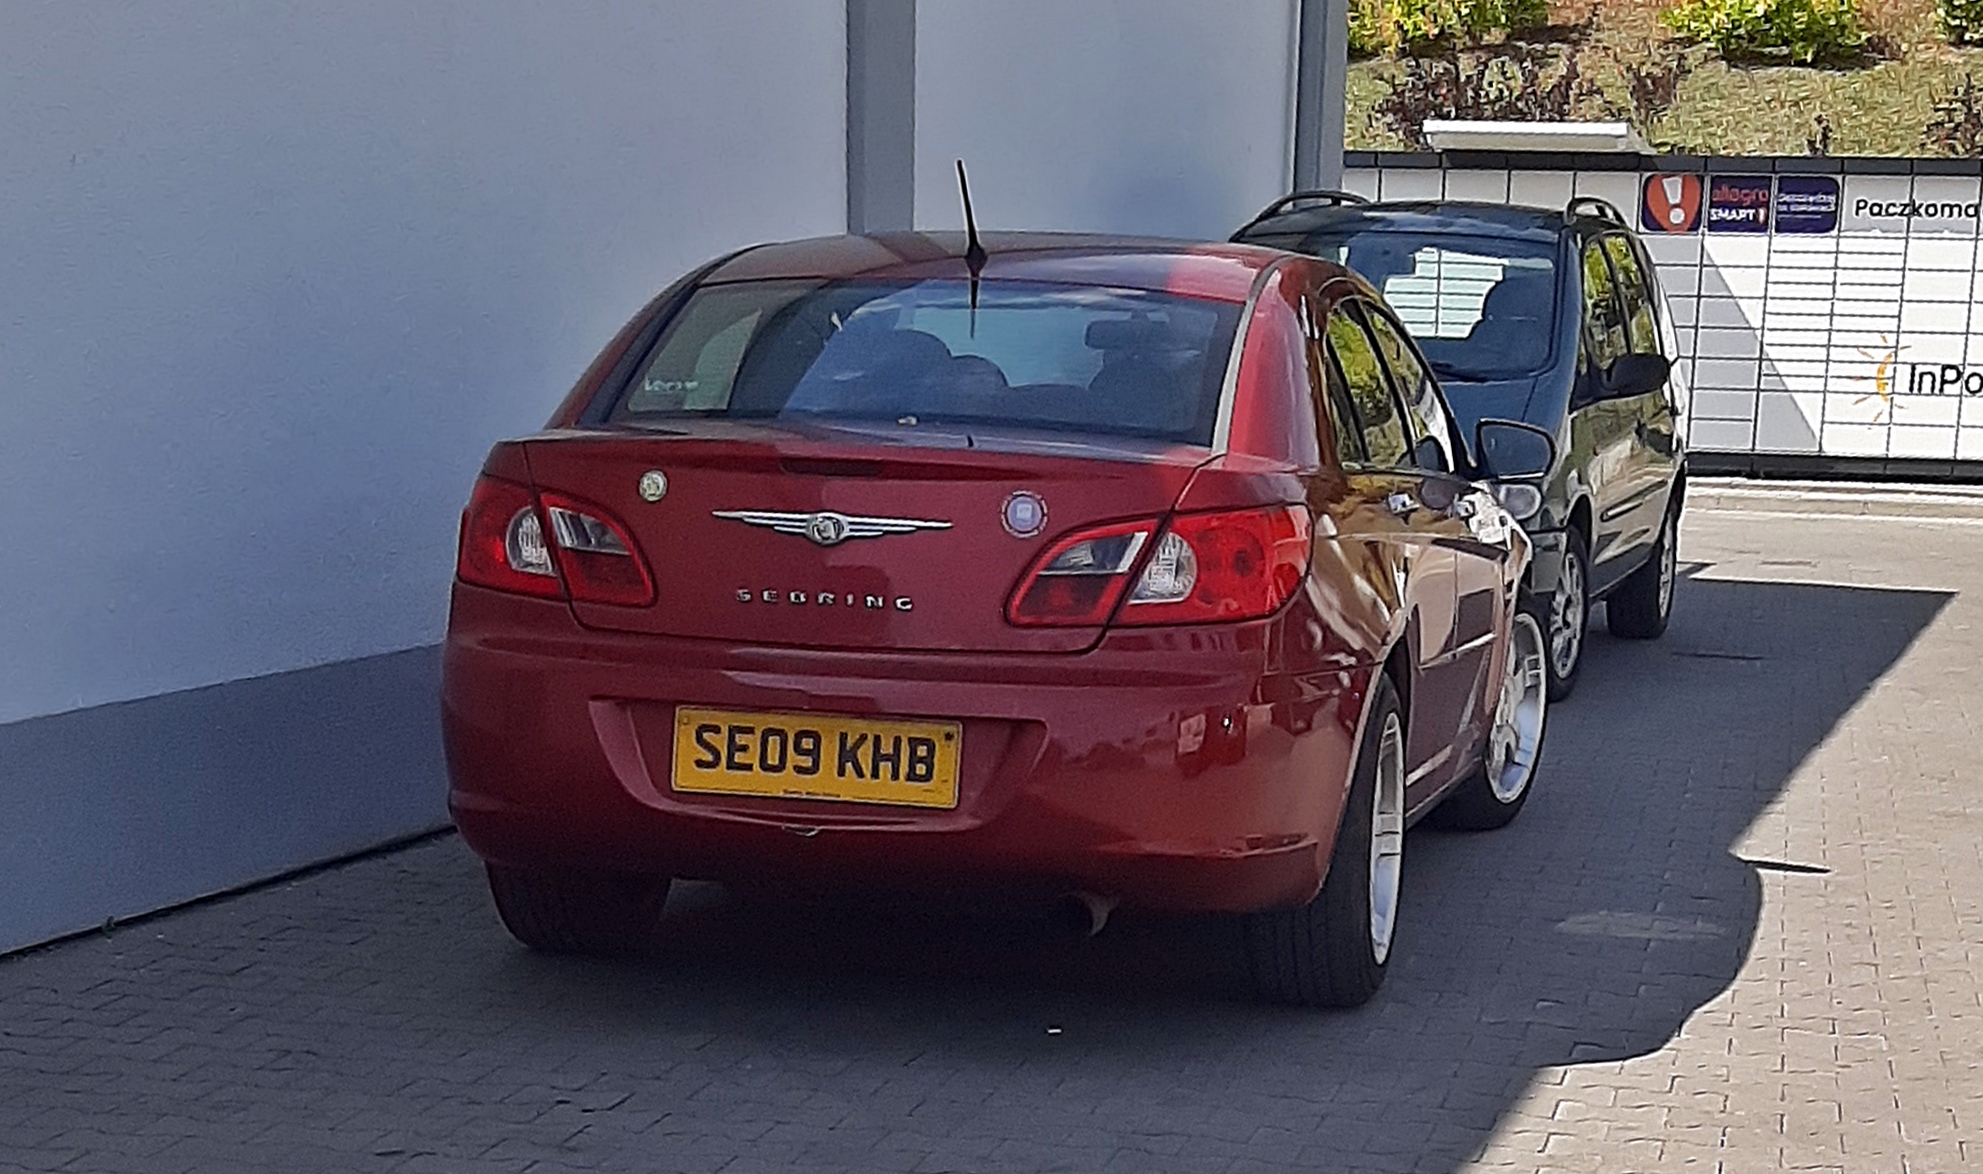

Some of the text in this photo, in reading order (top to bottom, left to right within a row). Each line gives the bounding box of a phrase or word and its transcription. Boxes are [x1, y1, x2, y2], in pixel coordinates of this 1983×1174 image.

[1711, 184, 1769, 206] allegro
[737, 589, 913, 611] SEBRING
[694, 723, 936, 783] SE09 KHB
